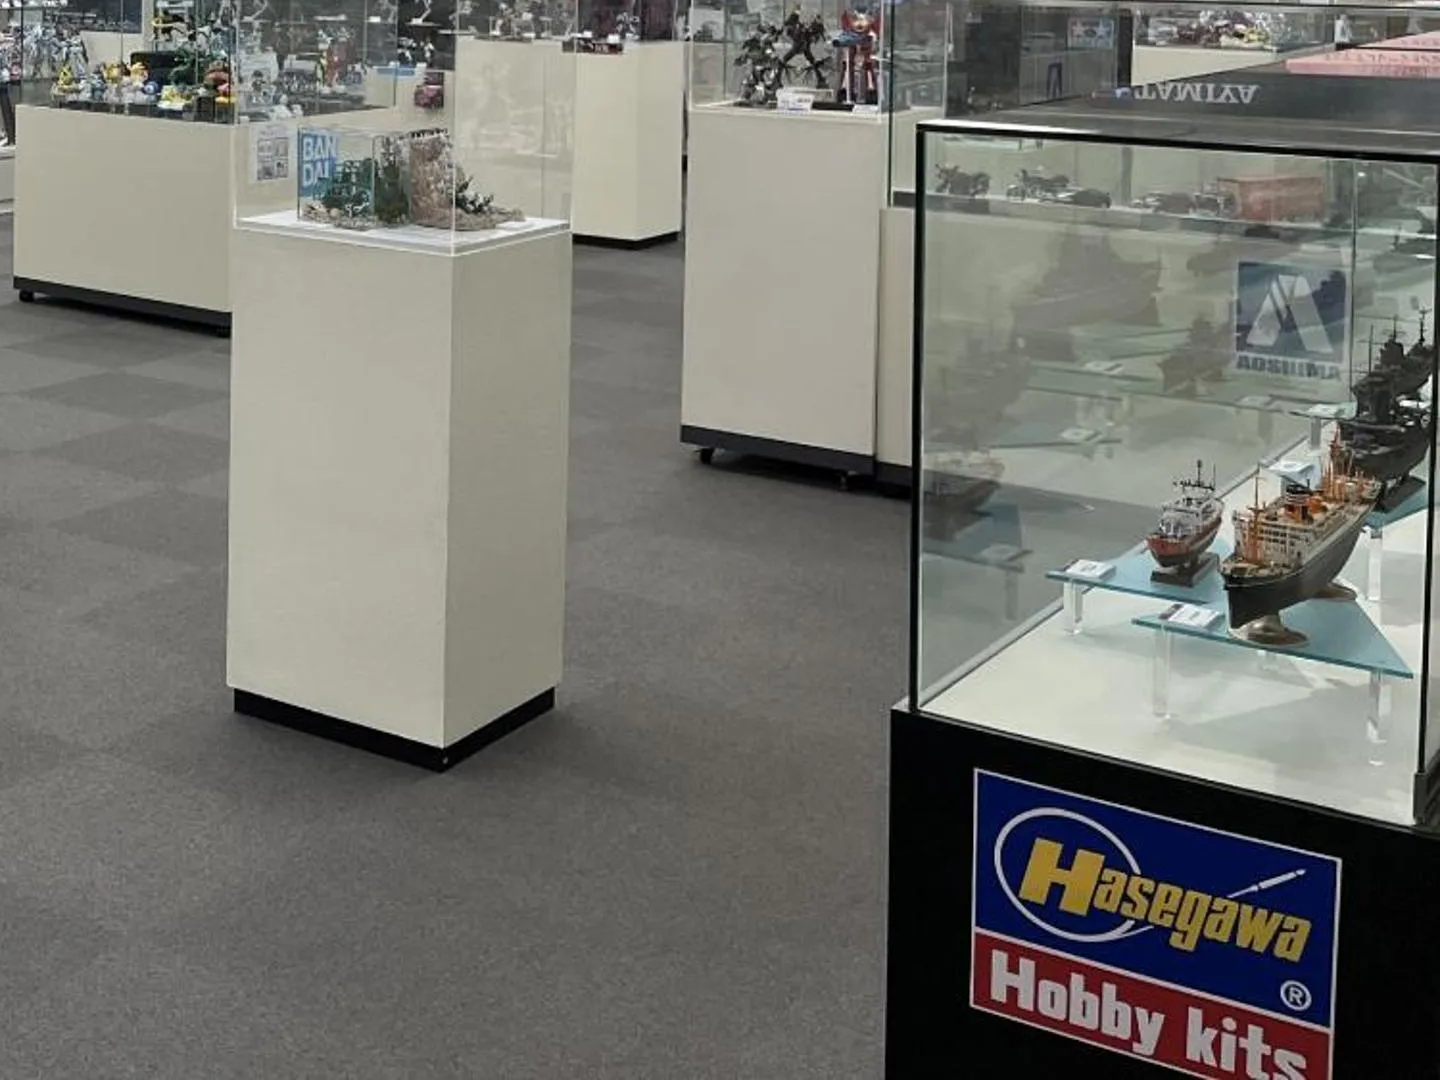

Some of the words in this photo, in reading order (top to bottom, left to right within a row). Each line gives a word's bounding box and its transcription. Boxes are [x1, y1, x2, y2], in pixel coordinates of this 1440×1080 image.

[303, 135, 337, 160] BAN
[1019, 837, 1312, 963] Hasegawa
[990, 948, 1166, 1056] Hobby
[1185, 1007, 1307, 1080] kits
